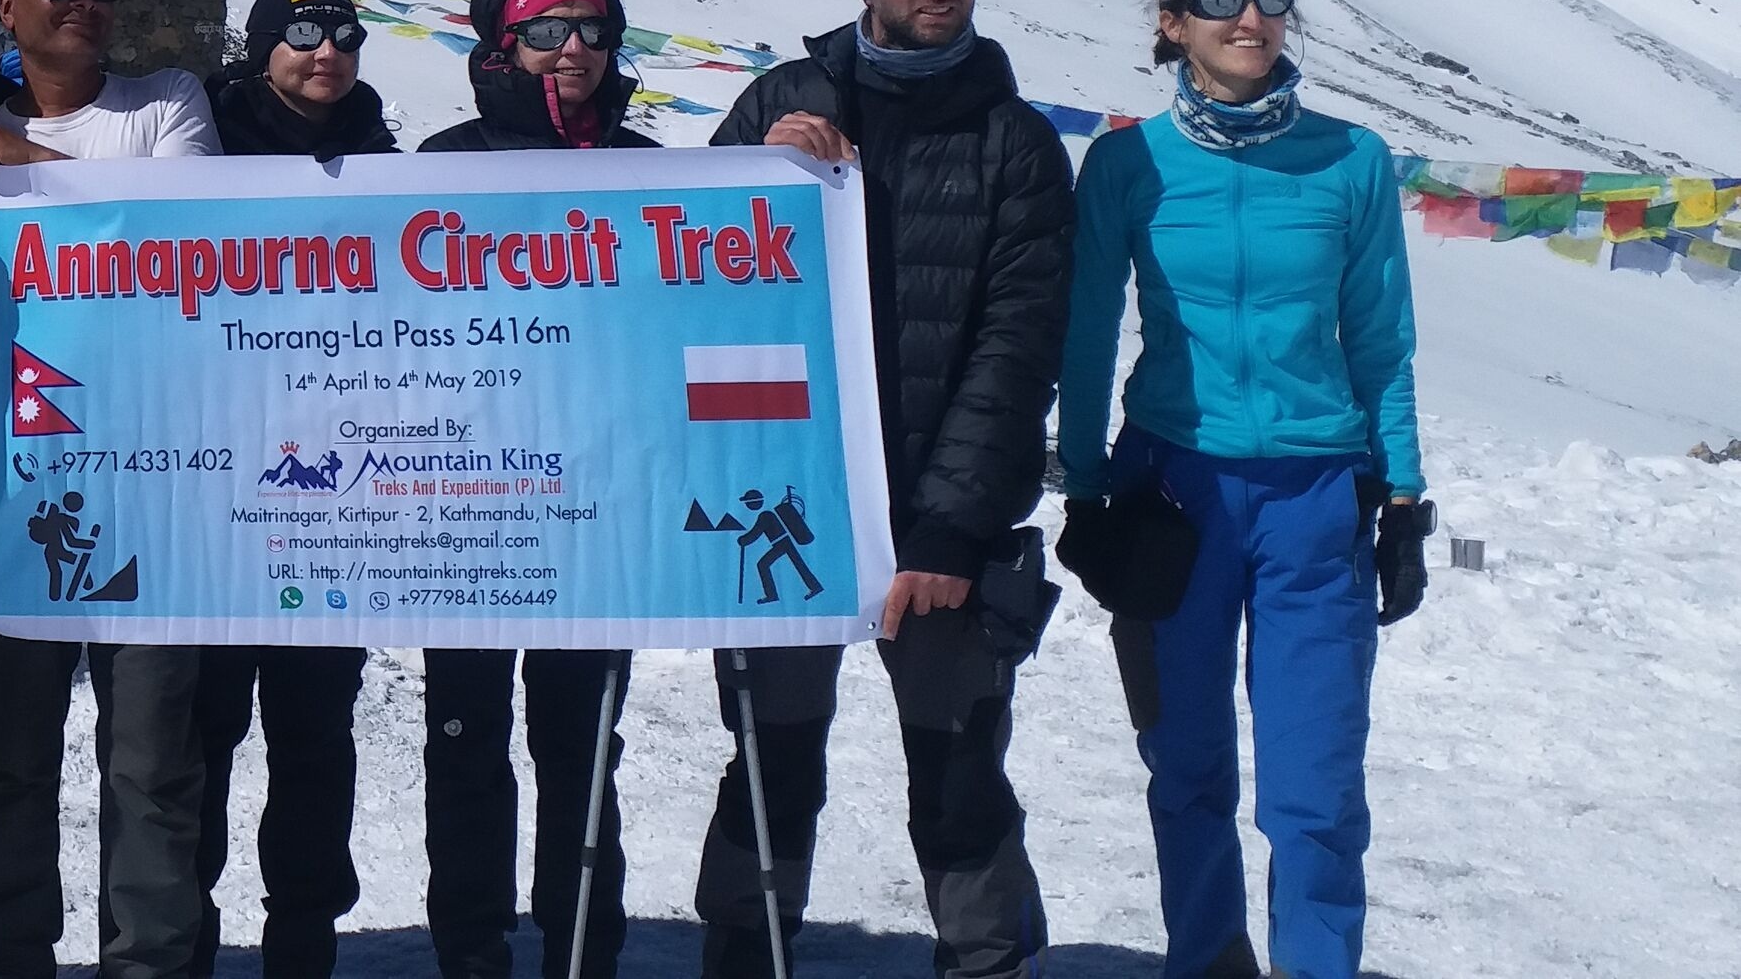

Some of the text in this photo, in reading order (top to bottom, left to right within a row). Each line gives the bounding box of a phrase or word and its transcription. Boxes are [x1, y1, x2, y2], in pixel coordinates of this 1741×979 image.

[10, 195, 804, 321] Annapurna Circuit Trek
[220, 316, 571, 358] Thorang-La Pass 5416m
[284, 369, 522, 395] 14th April to 4th May 2019
[339, 417, 473, 443] Organized By:
[47, 448, 234, 476] +97714331402
[345, 448, 563, 486] Mountain King
[372, 477, 565, 498] Treks And Expedition (P) Ltd.
[230, 507, 331, 527] Maitrinagar,
[338, 505, 400, 524] Kirtipur
[417, 505, 434, 524] 2,
[439, 502, 540, 524] Kathmandu,
[546, 501, 598, 524] Nepal
[288, 531, 540, 554] mountainkingtreks@gmail.com
[268, 561, 557, 584] URL: http://mountainkingtreks.com
[398, 589, 558, 606] +9779841566449
